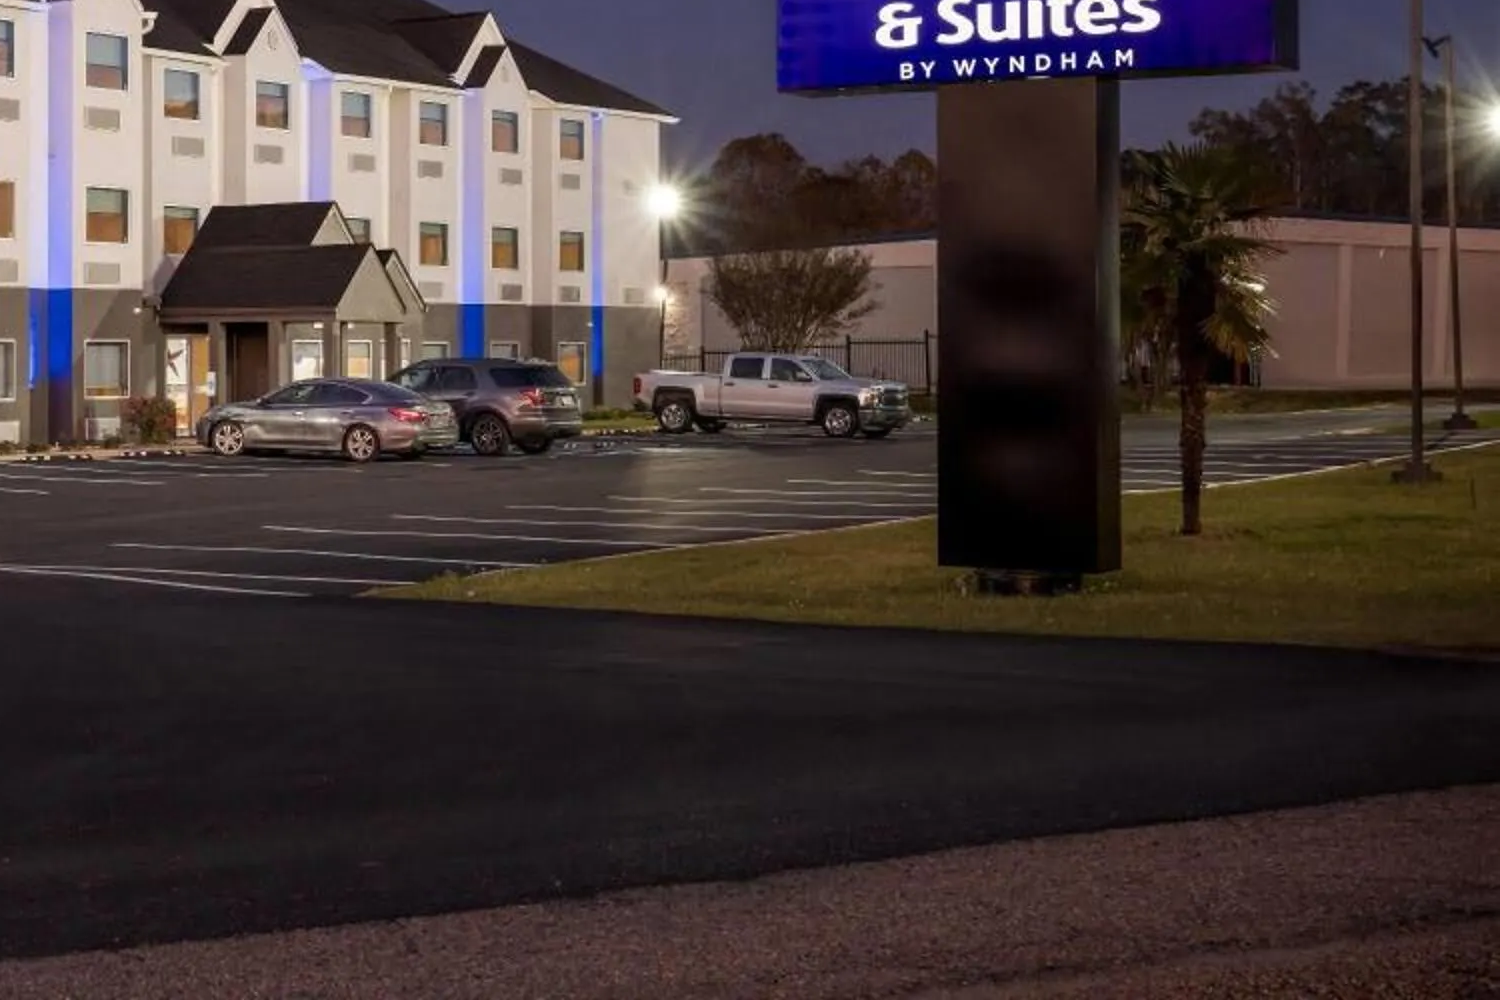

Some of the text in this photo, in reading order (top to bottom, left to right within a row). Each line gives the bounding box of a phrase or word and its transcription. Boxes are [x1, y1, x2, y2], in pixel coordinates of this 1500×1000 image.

[875, 3, 923, 48] &
[900, 49, 1135, 80] BY WYNDHAM
